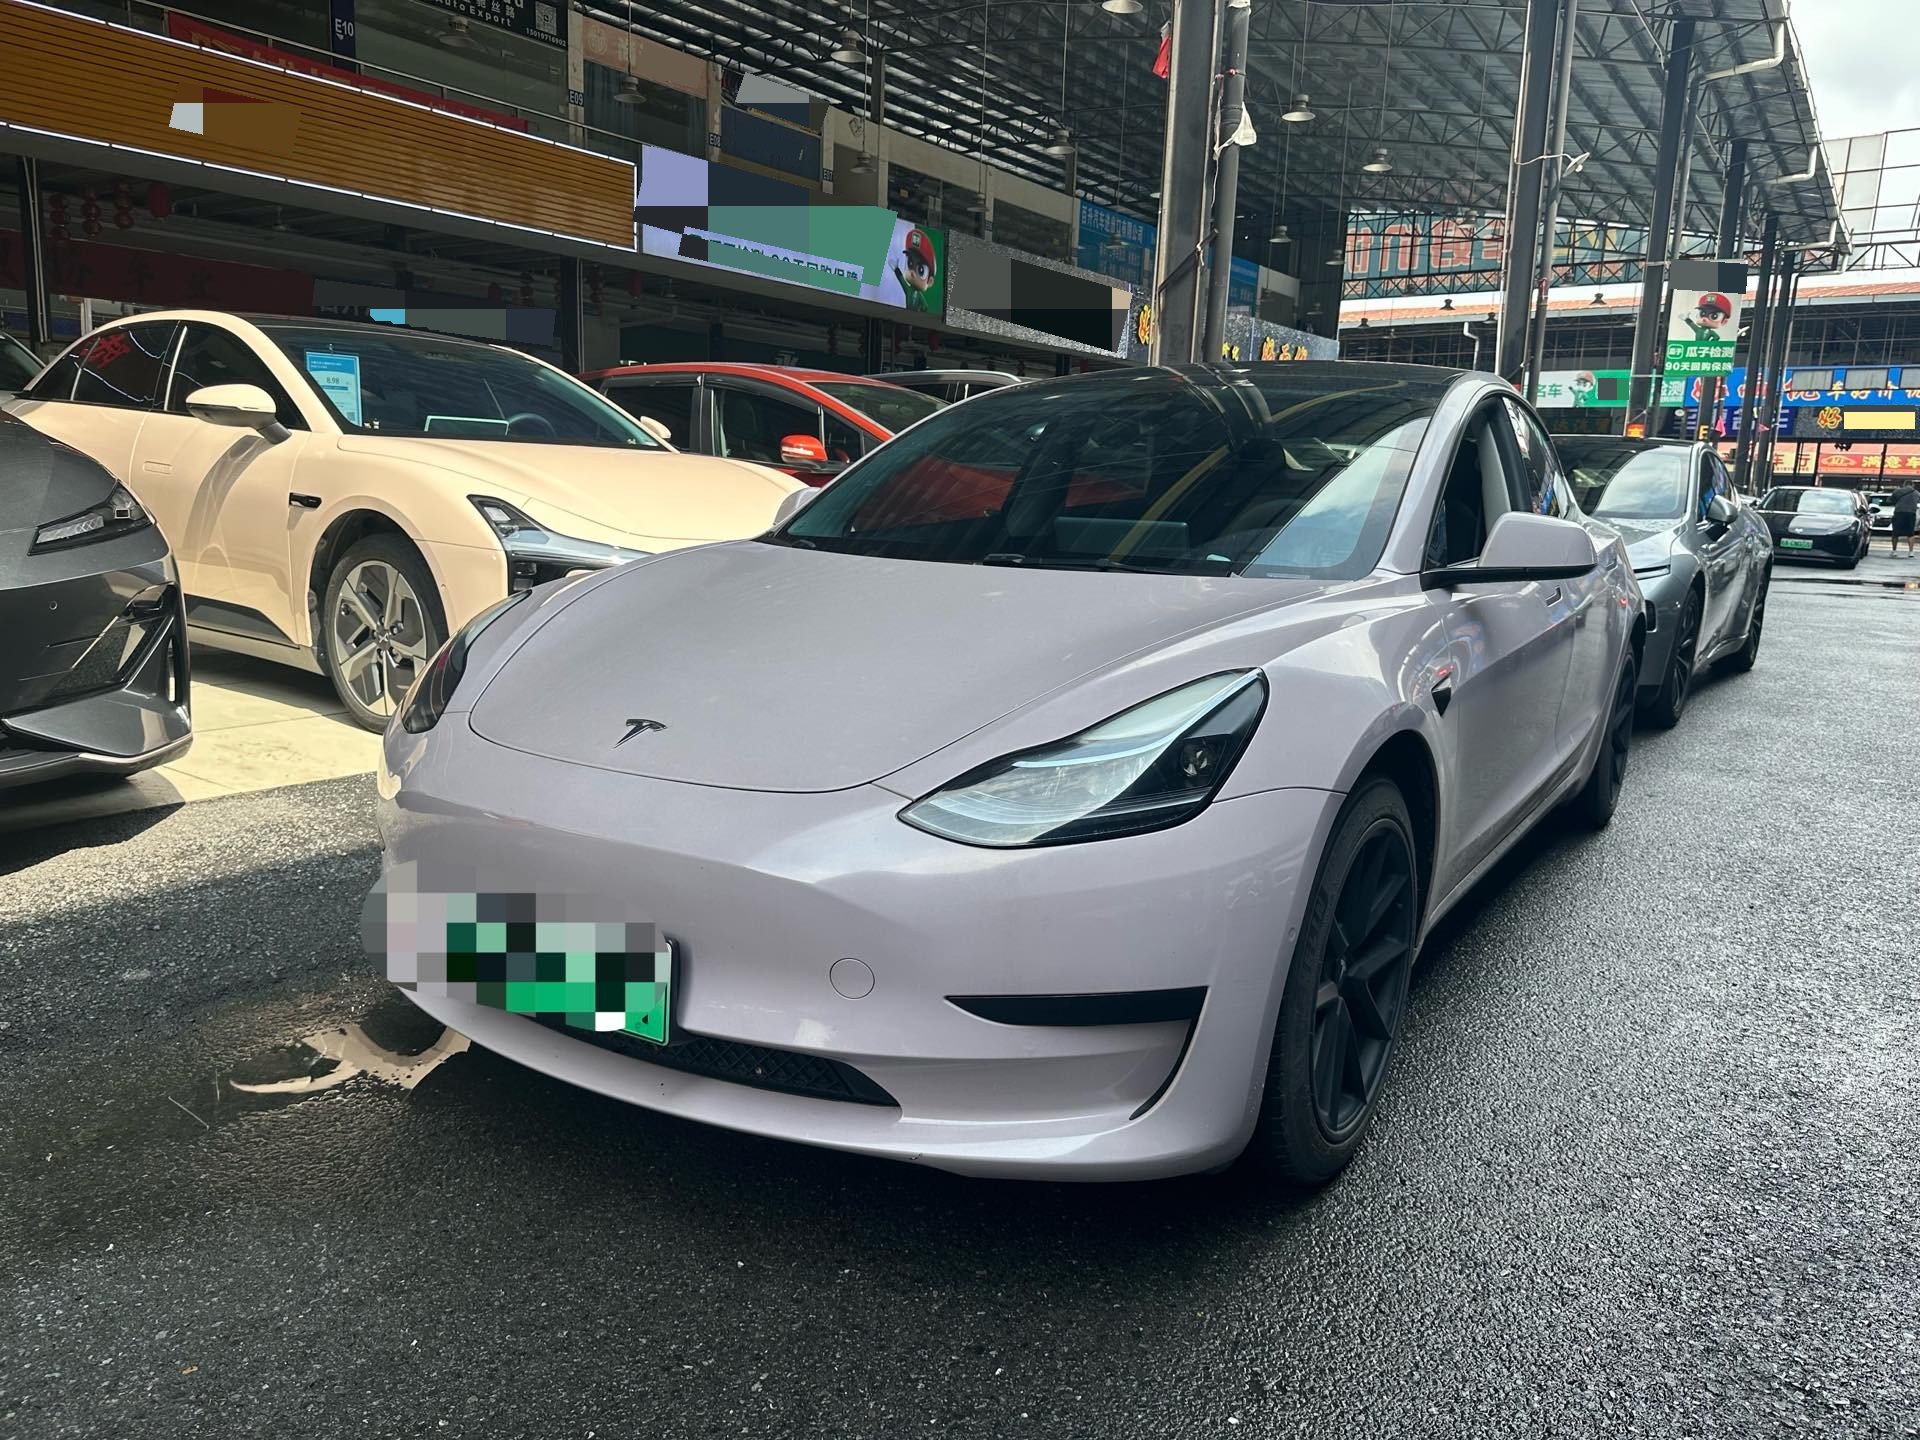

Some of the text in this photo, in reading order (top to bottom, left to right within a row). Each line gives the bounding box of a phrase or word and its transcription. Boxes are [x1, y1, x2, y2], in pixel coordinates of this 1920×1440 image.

[469, 7, 512, 27] Export
[335, 18, 354, 37] E10
[569, 90, 583, 106] E09
[1685, 346, 1734, 358] 瓜子检测
